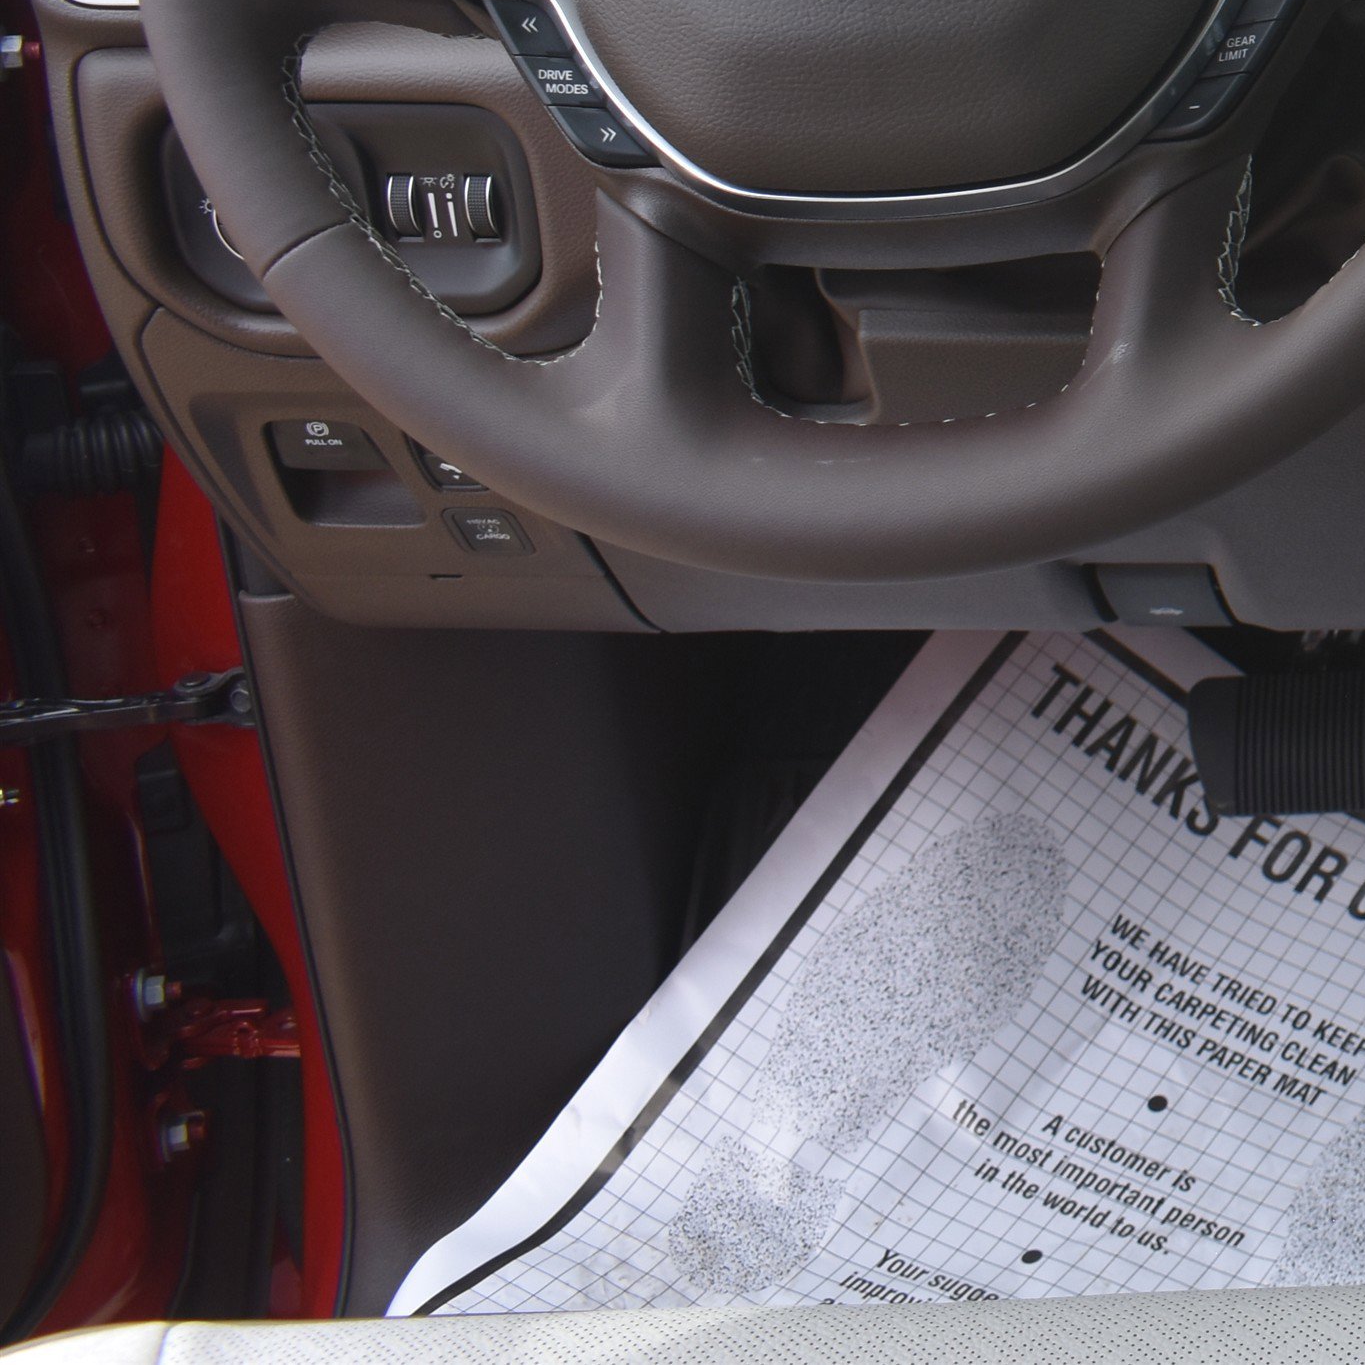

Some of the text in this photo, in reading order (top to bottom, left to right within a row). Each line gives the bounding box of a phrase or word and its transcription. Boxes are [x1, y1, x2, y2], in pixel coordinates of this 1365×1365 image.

[538, 69, 573, 81] DRIVE
[1218, 48, 1249, 62] LIMIT
[1226, 34, 1256, 48] GEAR
[545, 83, 589, 95] MODES
[305, 438, 327, 446] PULL
[1029, 664, 1218, 836] THANKS
[1229, 814, 1348, 902] FOR
[1111, 913, 1150, 951] WE
[1148, 940, 1211, 985] HAVE
[1211, 972, 1277, 1015] TRIED
[1281, 1003, 1311, 1030] TO
[1080, 974, 1327, 1107] WITH THIS PAPER MAT
[1090, 939, 1357, 1086] YOUR CARPETING CLEAN
[952, 1098, 1247, 1248] the most important person
[1041, 1114, 1197, 1192] A customer is
[974, 1158, 1172, 1256] in the world to us.
[876, 1249, 929, 1282] Your
